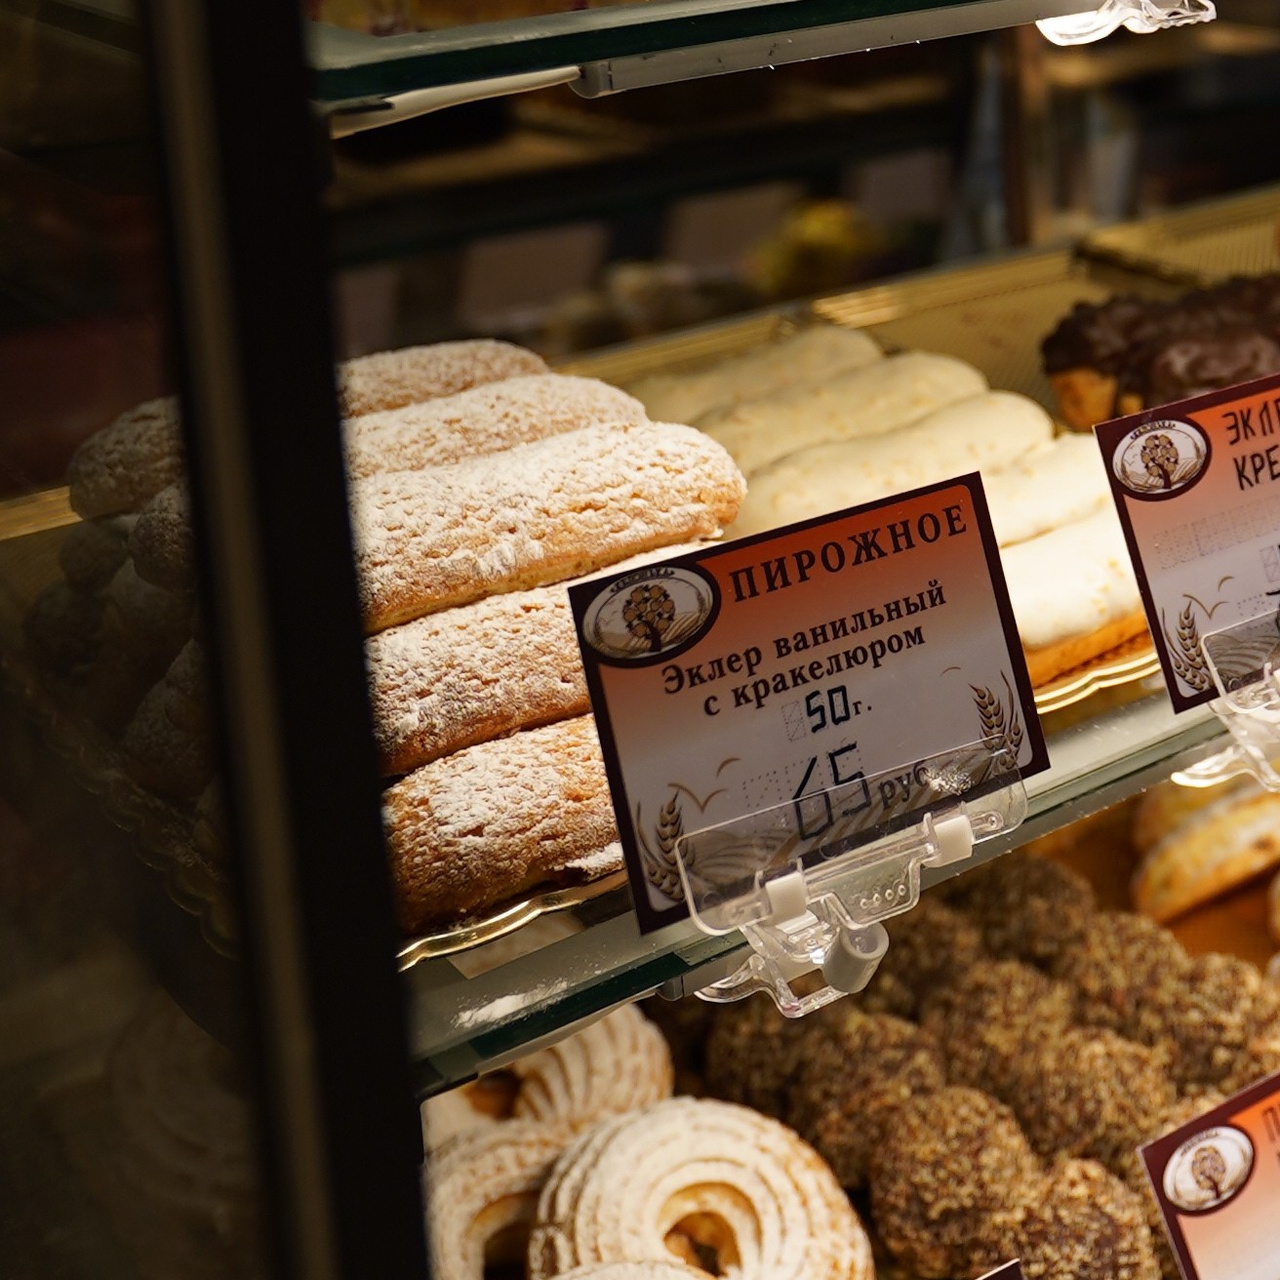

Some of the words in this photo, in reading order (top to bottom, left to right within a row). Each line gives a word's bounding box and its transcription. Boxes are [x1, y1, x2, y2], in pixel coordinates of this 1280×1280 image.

[729, 505, 967, 602] ПИРОЖНОЕ
[662, 647, 763, 694] Эклер
[775, 580, 947, 652] ванильный
[704, 695, 719, 716] с
[732, 626, 926, 709] кракелюром
[792, 741, 872, 841] 65
